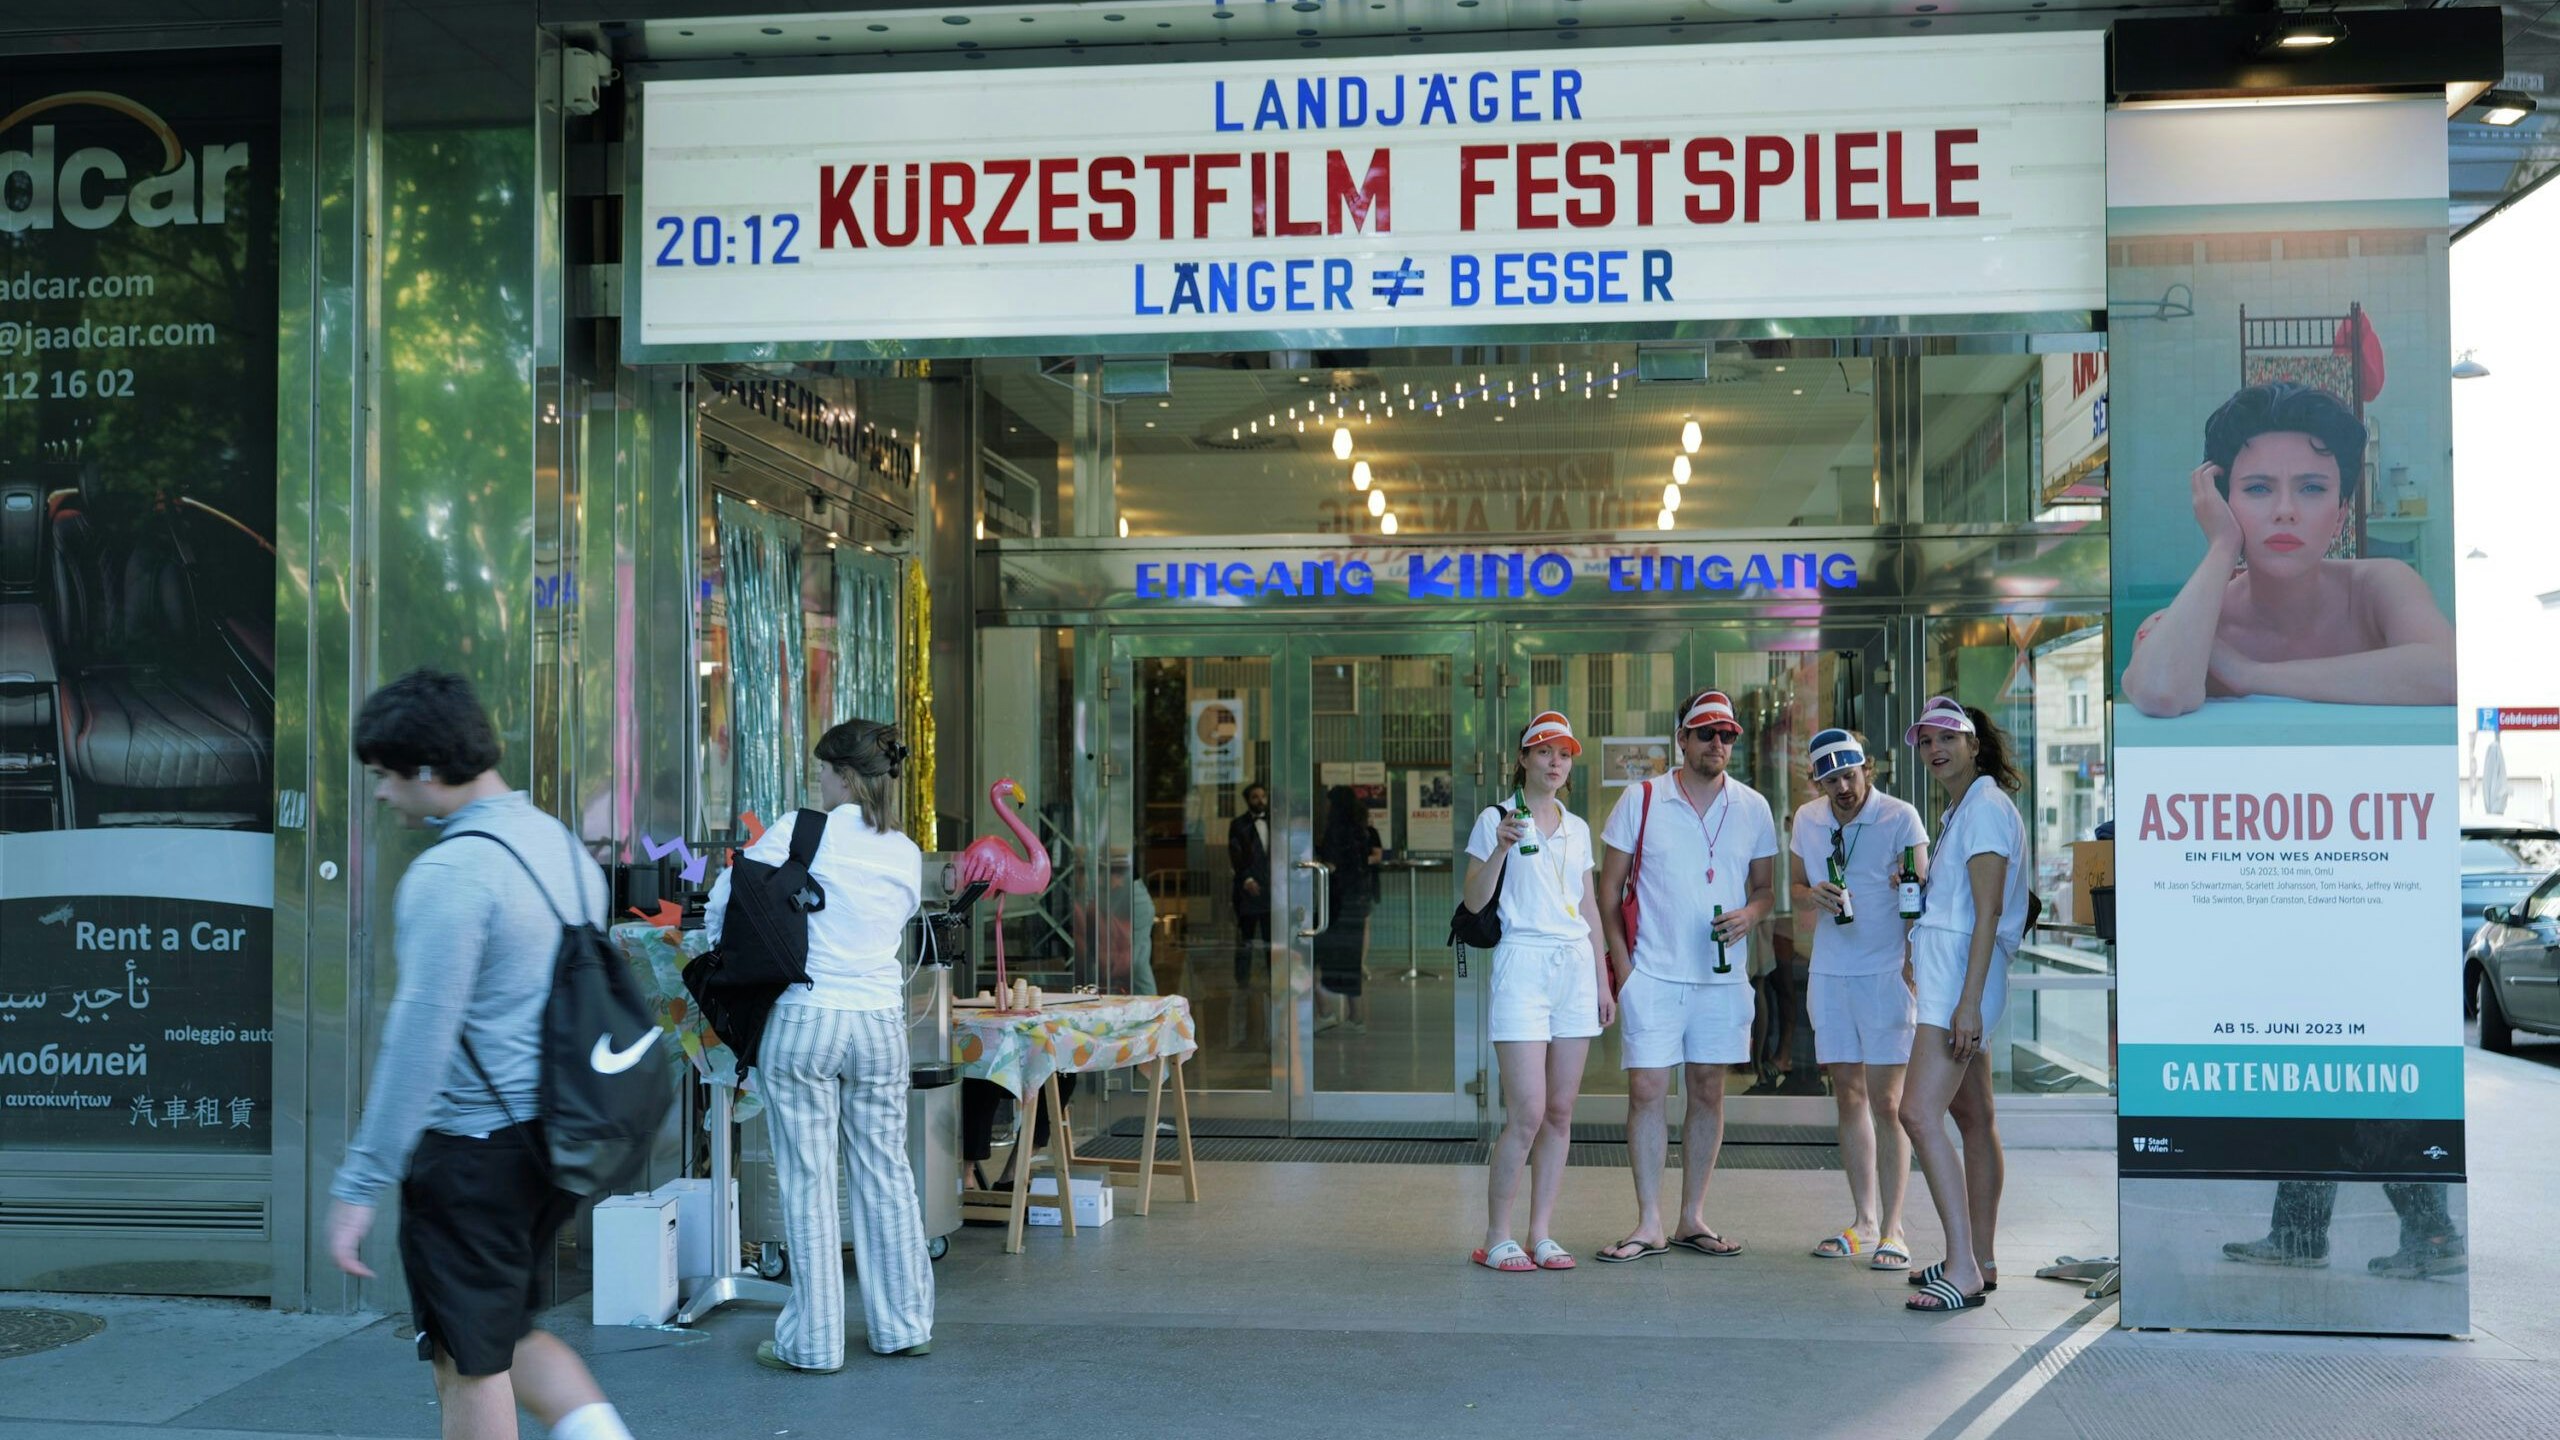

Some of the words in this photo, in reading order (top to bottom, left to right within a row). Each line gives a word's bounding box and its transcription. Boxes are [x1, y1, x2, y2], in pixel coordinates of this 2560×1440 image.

[1215, 69, 1583, 132] LANDJÄGER
[655, 212, 801, 267] 20:12
[819, 148, 1391, 250] KÜRZESTFILM
[1459, 128, 1980, 232] FESTSPIELE
[1134, 258, 1355, 316] LÄNGER
[1450, 249, 1674, 308] BESSER
[0, 318, 216, 357] @jaadcar.com
[3, 371, 39, 400] 12
[50, 370, 88, 399] 16
[96, 368, 135, 397] 02
[1136, 560, 1375, 598] EINGANG
[1408, 552, 1574, 599] KINO
[1608, 553, 1858, 592] EINGANG
[2138, 793, 2334, 841] ASTEROID
[2349, 793, 2435, 841] CITY
[2185, 851, 2207, 862] EIN
[2211, 851, 2241, 862] FILM
[2246, 851, 2275, 862] VON
[2280, 851, 2309, 862] WES
[2314, 851, 2389, 862] ANDERSON
[2240, 867, 2256, 876] USA
[2281, 867, 2294, 876] 104
[2154, 881, 2165, 890] Mit
[2168, 881, 2189, 890] Jason
[2246, 881, 2274, 890] Scarlett
[2320, 881, 2336, 890] Tom
[2366, 881, 2391, 892] Jeffrey
[2192, 895, 2210, 904] Tilda
[2247, 895, 2269, 906] Bryan
[2308, 895, 2337, 904] Edward
[2339, 895, 2366, 904] Norton
[76, 921, 152, 951] Rent
[161, 928, 180, 951] a
[190, 921, 246, 951] Car
[61, 959, 151, 1023] تأجير
[164, 1025, 236, 1046] noleggio
[2213, 1023, 2235, 1035] AB
[2239, 1023, 2260, 1035] 15.
[2264, 1023, 2300, 1035] JUNI
[2305, 1023, 2342, 1035] 2023
[2348, 1023, 2365, 1035] IM
[2162, 1061, 2420, 1093] GARTENBAUKINO
[5, 1090, 112, 1111] αυτοκινήτων
[129, 1094, 257, 1130] 汽車租賃
[2148, 1137, 2169, 1145] Stadt
[2148, 1145, 2169, 1153] Wien
